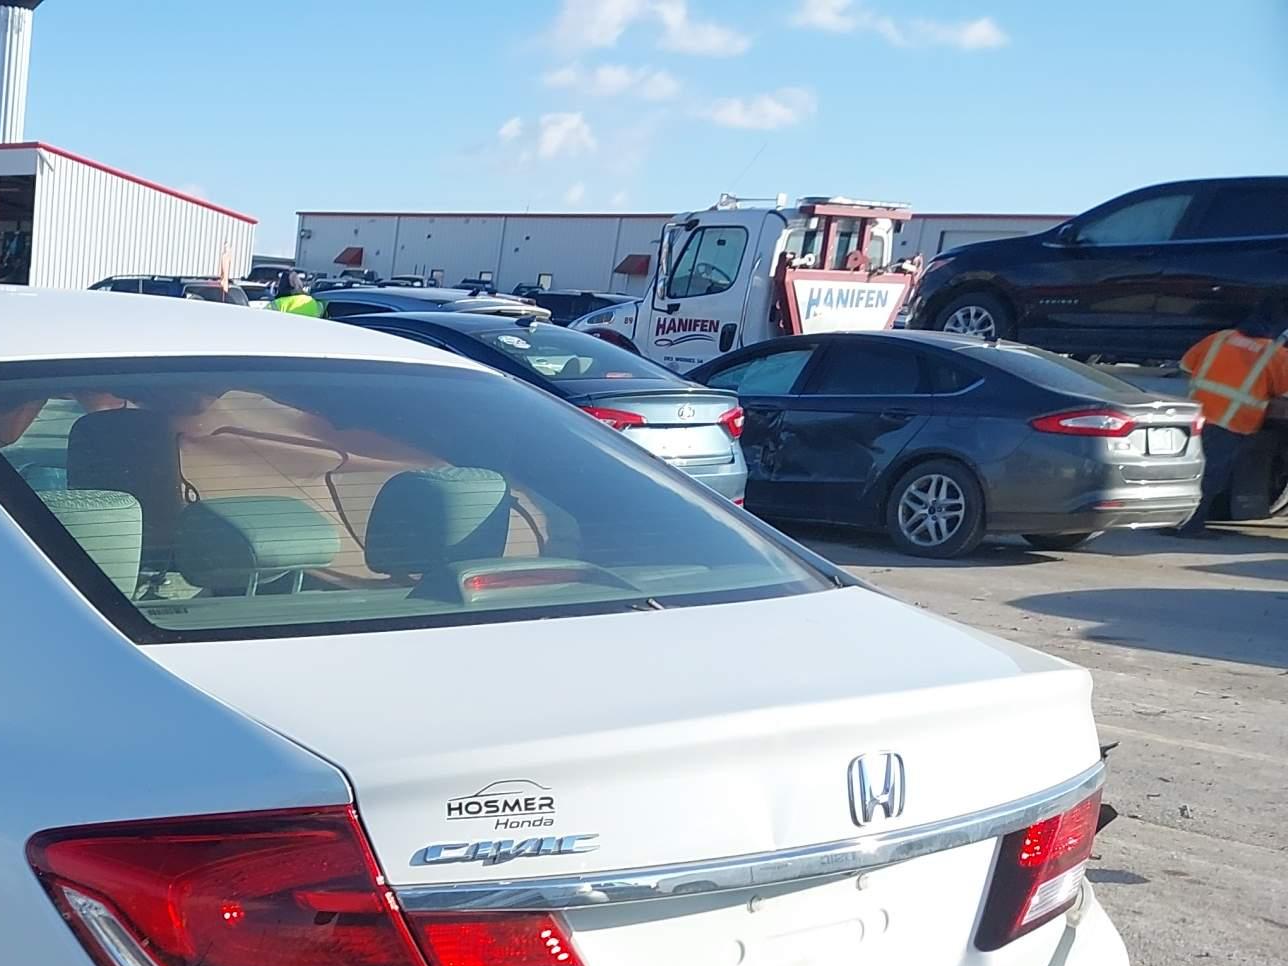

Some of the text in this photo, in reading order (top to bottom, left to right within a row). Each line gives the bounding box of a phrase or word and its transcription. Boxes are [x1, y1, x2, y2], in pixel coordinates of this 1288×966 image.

[805, 287, 889, 320] HANIFEN
[655, 317, 720, 336] HANIFEN
[447, 796, 555, 817] HOSMER
[494, 816, 554, 830] Honda
[408, 833, 600, 867] CIVIC
